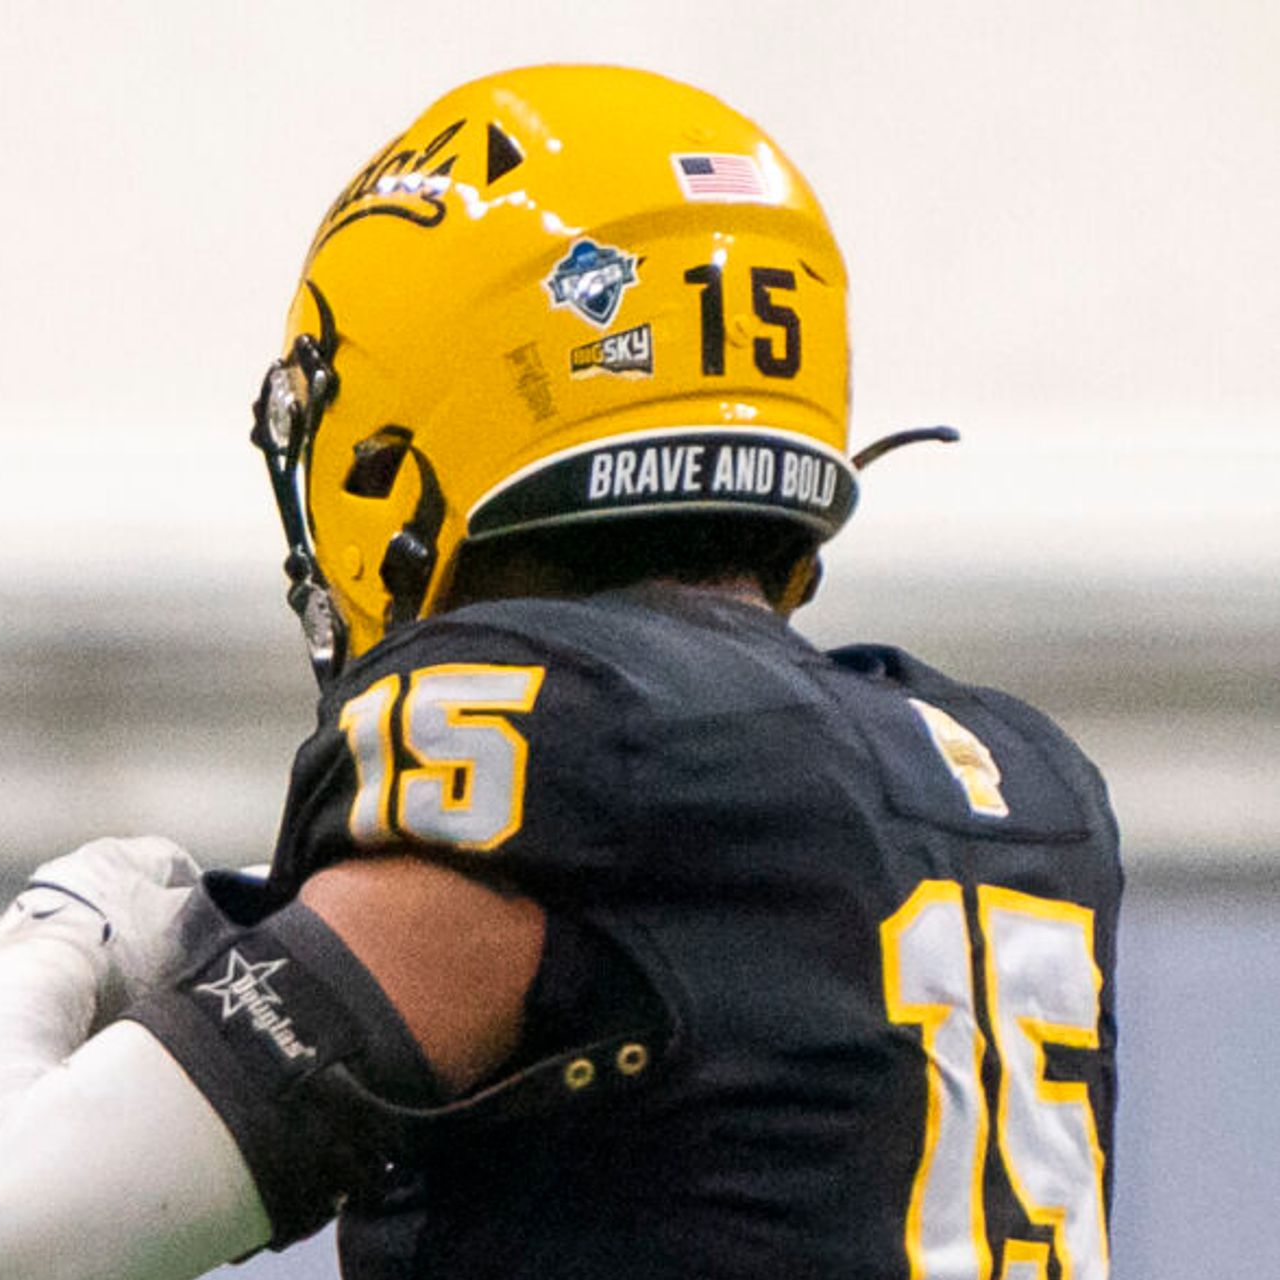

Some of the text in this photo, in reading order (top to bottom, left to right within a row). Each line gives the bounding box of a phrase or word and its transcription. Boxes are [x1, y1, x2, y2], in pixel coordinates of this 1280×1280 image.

[684, 263, 801, 380] 15
[590, 446, 838, 507] BRAVE AND BOLD
[338, 663, 546, 852] 15
[231, 972, 307, 1059] Douglas
